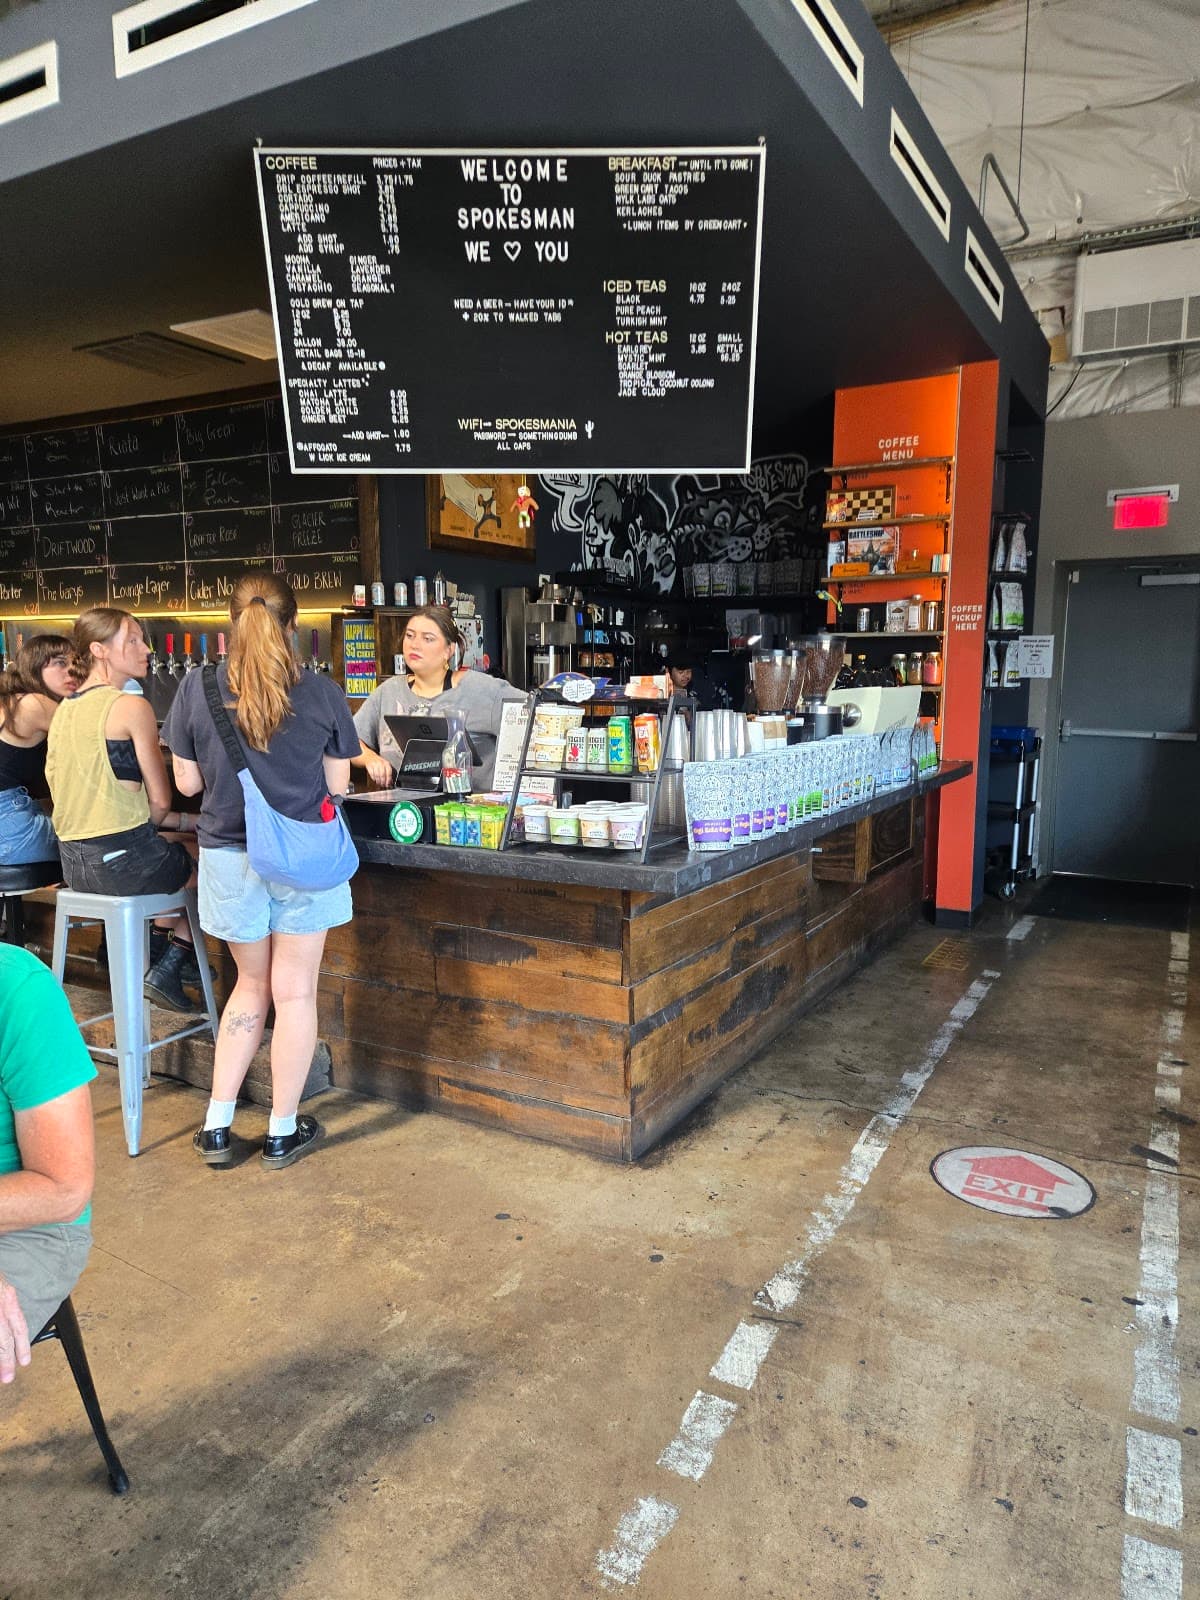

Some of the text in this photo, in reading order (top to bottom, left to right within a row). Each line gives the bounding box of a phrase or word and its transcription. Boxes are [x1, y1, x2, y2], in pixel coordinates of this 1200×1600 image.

[266, 156, 421, 170] COFFEE PRICES TAX
[608, 157, 677, 171] BREAKFAST
[689, 159, 711, 171] UNTIL
[460, 158, 568, 182] WELCOME
[276, 174, 296, 185] DRIP
[615, 172, 706, 183] SOUR DUCK PASTRIES
[296, 184, 339, 195] ESPRESSO
[342, 185, 361, 195] SHOT
[615, 184, 638, 195] GREEN
[664, 184, 688, 195] TACOS
[278, 194, 314, 204] CORTADO
[500, 184, 522, 206] TO
[616, 194, 676, 205] MYLK LABS OATS
[279, 204, 330, 214] CAPPUCCINO
[280, 212, 326, 224] AMERICANO
[457, 208, 575, 230] SPOKESMAN
[281, 223, 307, 233] LATTE
[627, 220, 652, 231] LUNCH
[657, 220, 679, 231] ITEMS
[684, 220, 694, 230] BY
[297, 234, 338, 244] ADD SHOT
[298, 244, 314, 254] ADD
[318, 244, 344, 254] SYRUP
[464, 241, 569, 263] WE YOU
[284, 255, 377, 265] MOCHA GINGER
[286, 264, 391, 275] VANILLA LAVENDER
[286, 274, 382, 284] CARAMEL ORANGE
[288, 282, 332, 293] PISTACHIO
[603, 280, 632, 293] ICED
[636, 280, 667, 293] TEAS
[290, 298, 364, 308] COLD BREW ON TAP
[454, 298, 567, 310] NEED A BEER HAVE YOUR ID
[616, 294, 640, 305] BLACK
[616, 306, 660, 316] PURE PEACH
[493, 312, 504, 323] TO
[508, 312, 539, 323] WALKED
[544, 312, 562, 323] TABS
[616, 316, 668, 326] TURKISH MINT
[605, 331, 742, 344] HOT TEAS SMALL
[294, 338, 322, 348] GALLON
[296, 349, 322, 359] RETAIL
[325, 349, 342, 358] BAGS
[716, 344, 743, 354] KETTLE
[618, 354, 666, 363] MYSTIC MINT
[338, 362, 378, 372] AVAILABLE
[618, 362, 648, 371] SCARLET
[618, 370, 676, 380] ORANGE BLOSSOM
[288, 378, 361, 388] SPECIALTY LATTES
[620, 379, 654, 388] TROPICAL
[660, 379, 689, 388] COCONUT
[298, 390, 348, 398] CHAI LATTE
[618, 388, 666, 397] JADE CLOUD
[300, 398, 357, 408] MATCHA LATTE
[300, 407, 358, 416] GOLDEN CHILD
[302, 415, 326, 424] GINGER
[458, 418, 577, 430] WIFI SPOKESMANIA
[352, 431, 381, 440] ADD SHOT
[474, 432, 578, 440] PASSWORD SOMETHINGDUMB
[304, 443, 338, 452] AFFOGATO
[496, 442, 532, 451] ALL CAPS
[878, 436, 920, 450] COFFEE
[309, 454, 371, 462] W LICK ICE CREAM
[882, 450, 914, 462] MENU
[848, 529, 885, 540] BATTLESHIP
[42, 536, 96, 558] DRIFTWOOD
[286, 570, 342, 590] COLD BREW
[112, 576, 170, 608] Lounge Lager
[190, 578, 213, 601] Cider
[951, 604, 983, 613] COFFEE
[951, 614, 982, 622] PICKUP
[955, 622, 978, 631] HERE
[346, 624, 363, 640] HAPPY
[965, 1172, 1054, 1203] EXIT
